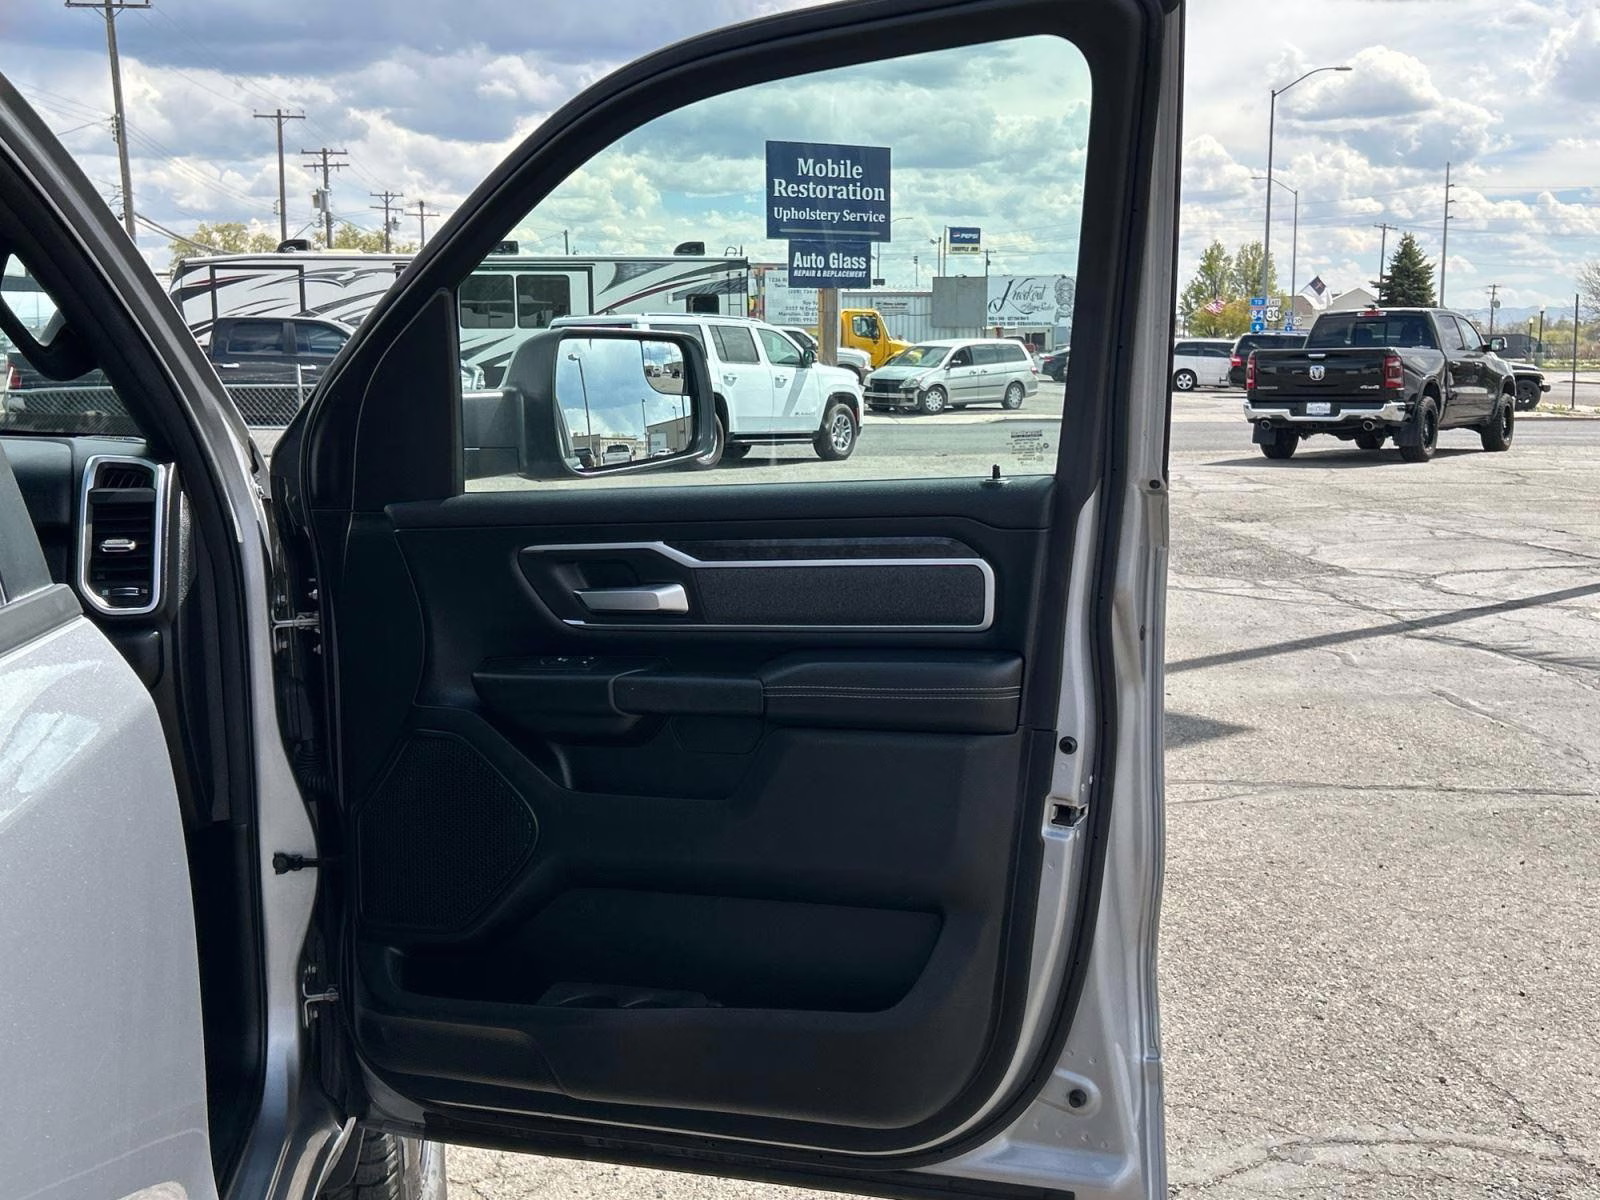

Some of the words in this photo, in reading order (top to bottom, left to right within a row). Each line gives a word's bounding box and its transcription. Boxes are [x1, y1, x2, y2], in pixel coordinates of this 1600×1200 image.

[797, 158, 863, 179] Mobile
[773, 178, 885, 201] Restoration
[773, 206, 841, 223] Upholstery
[843, 209, 886, 223] Service
[793, 251, 825, 268] Auto
[829, 252, 867, 269] Glass
[793, 269, 816, 277] REPAIR
[822, 270, 867, 278] REPLACEMENT
[1267, 309, 1280, 319] 30
